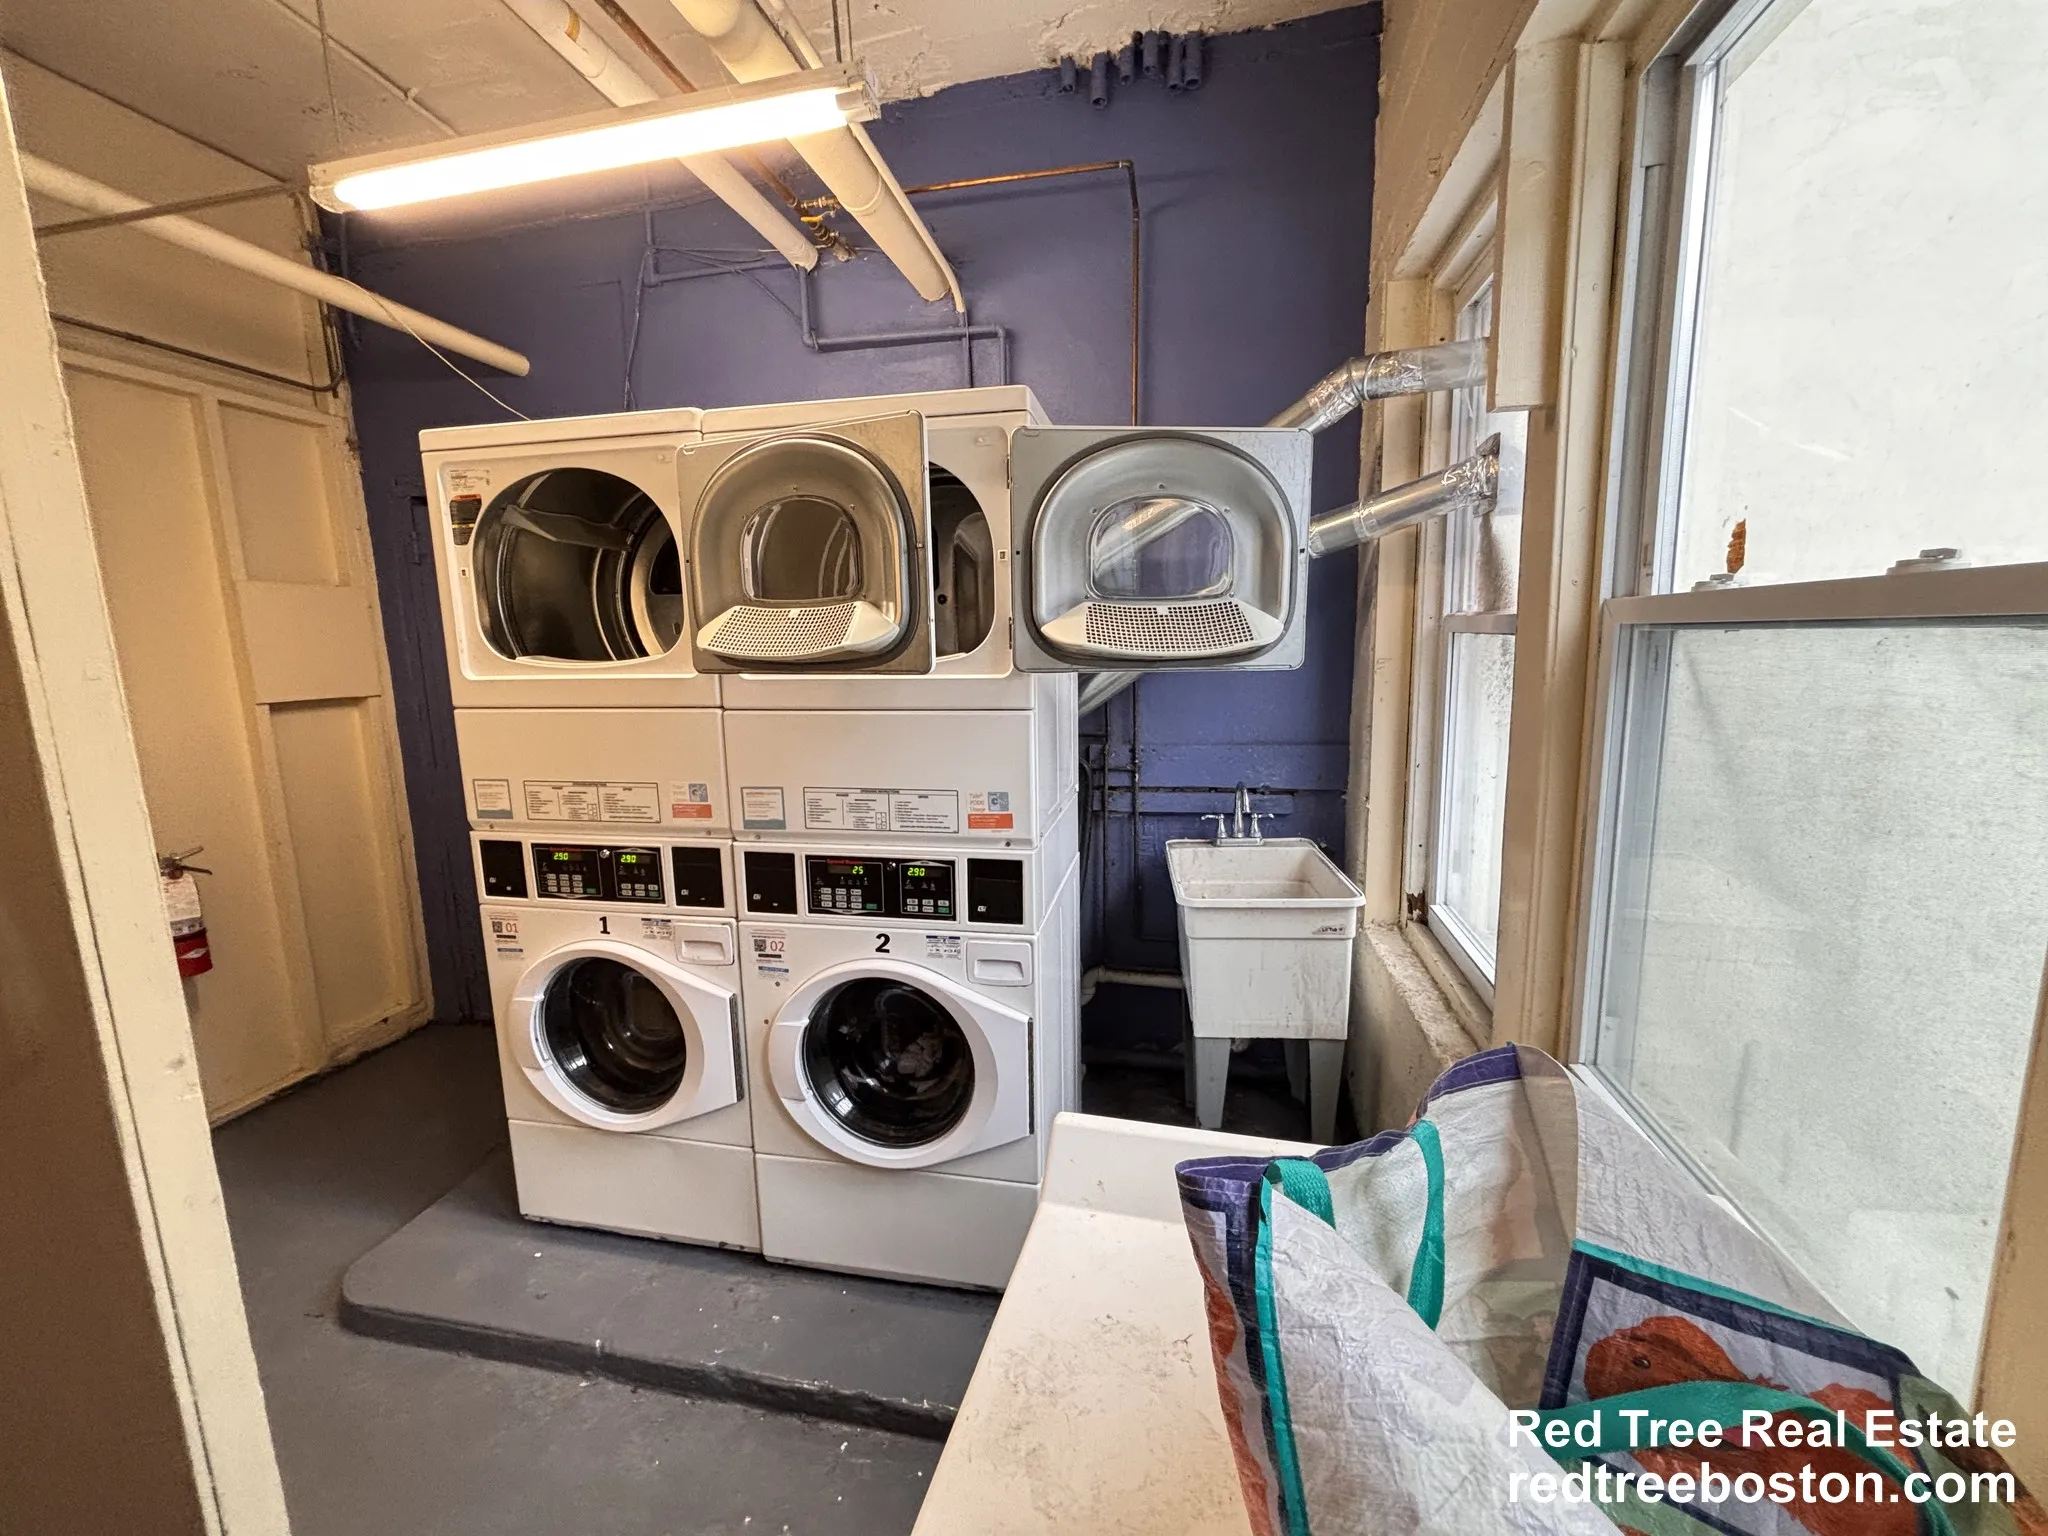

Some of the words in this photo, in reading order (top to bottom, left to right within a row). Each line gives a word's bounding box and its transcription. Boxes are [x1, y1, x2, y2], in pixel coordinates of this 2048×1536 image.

[852, 865, 864, 875] 25
[505, 922, 519, 934] 01
[599, 915, 611, 935] 1
[770, 940, 785, 952] 02
[875, 932, 891, 954] 2
